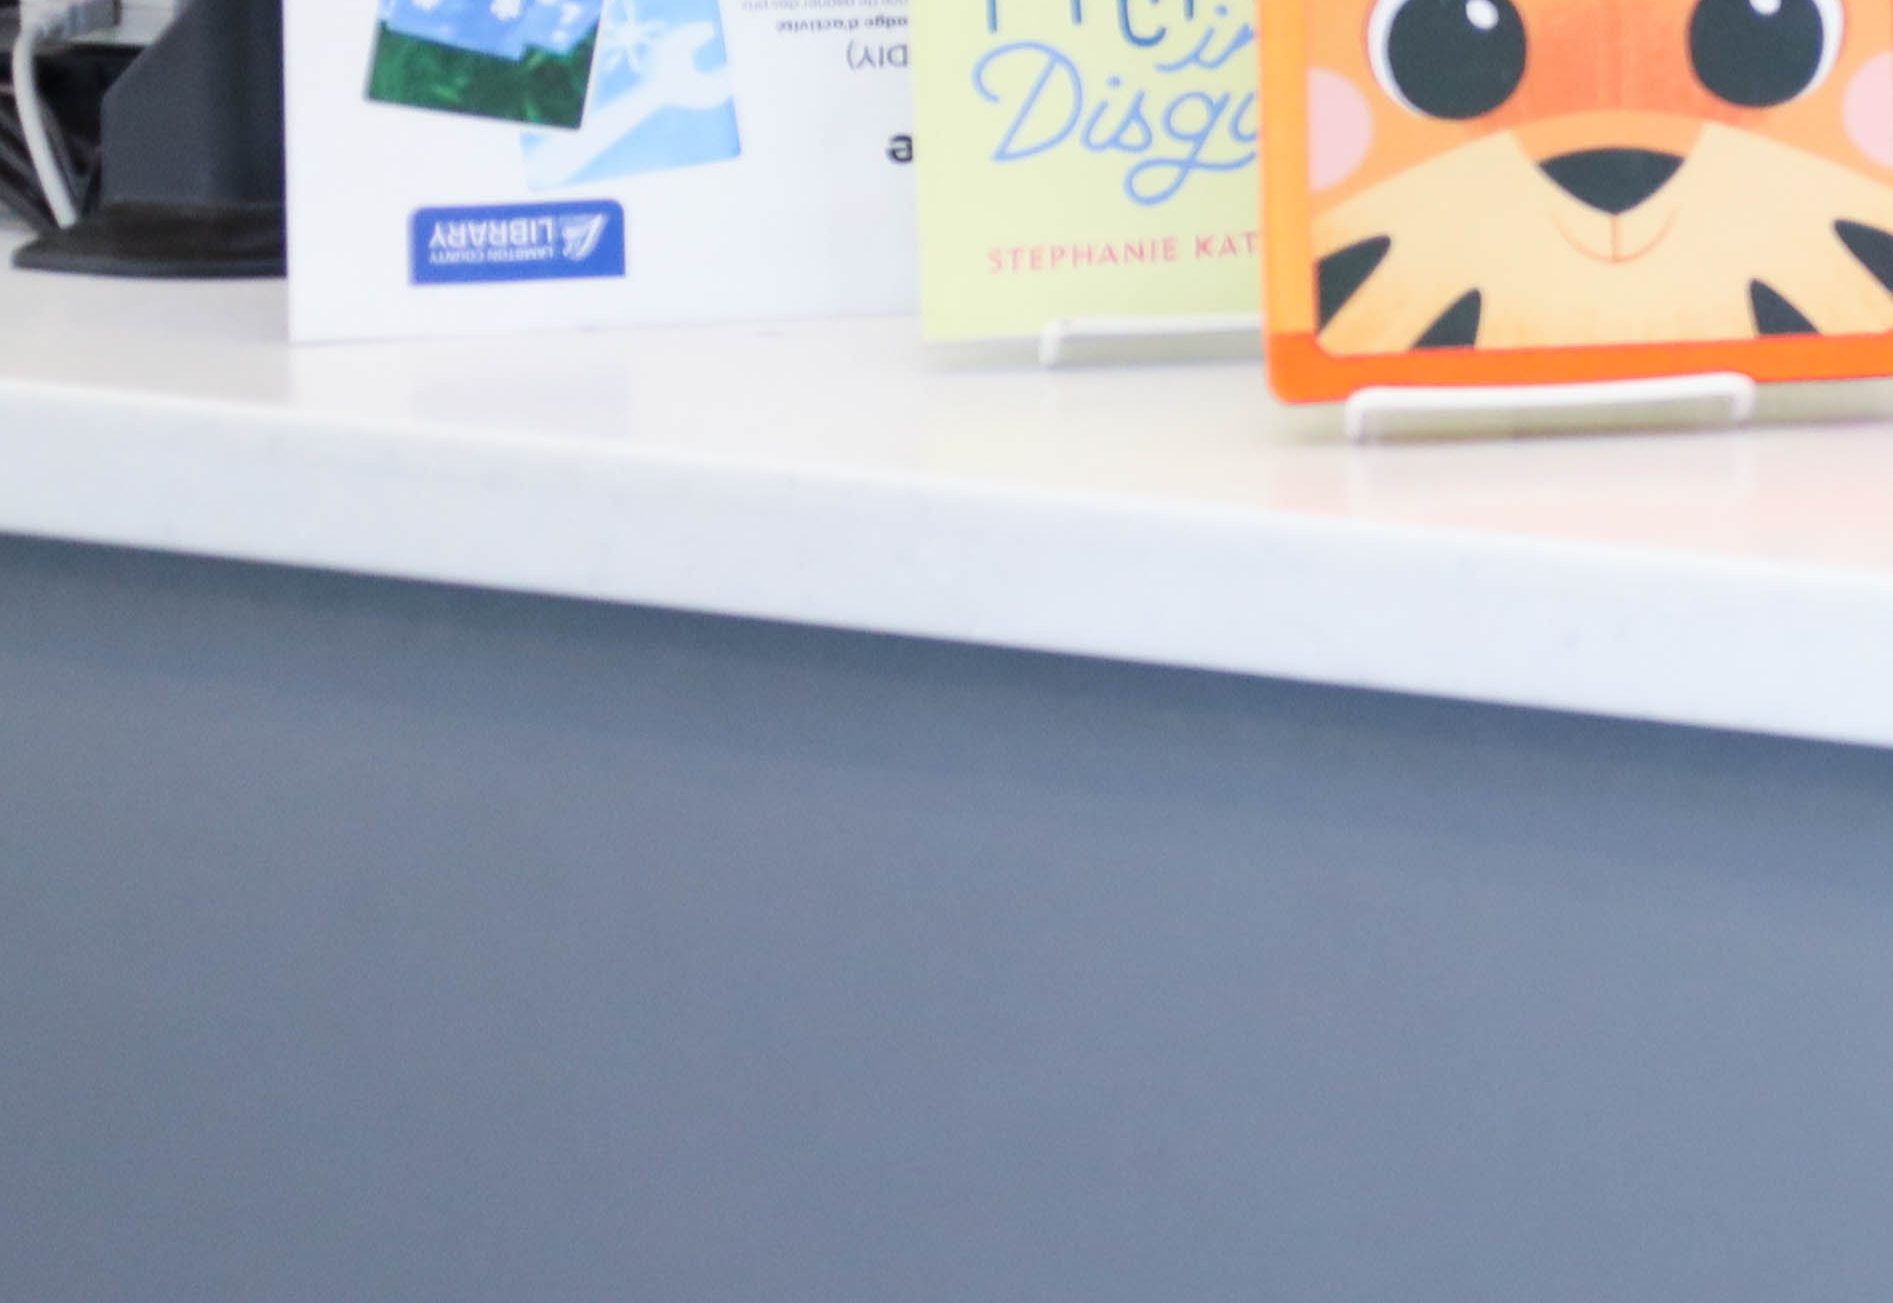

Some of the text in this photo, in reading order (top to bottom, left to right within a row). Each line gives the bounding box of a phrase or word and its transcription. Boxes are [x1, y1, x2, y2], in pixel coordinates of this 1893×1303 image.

[864, 13, 908, 29] adge
[427, 216, 555, 249] LIBRARY
[985, 230, 1258, 276] STEPHANIE KAT
